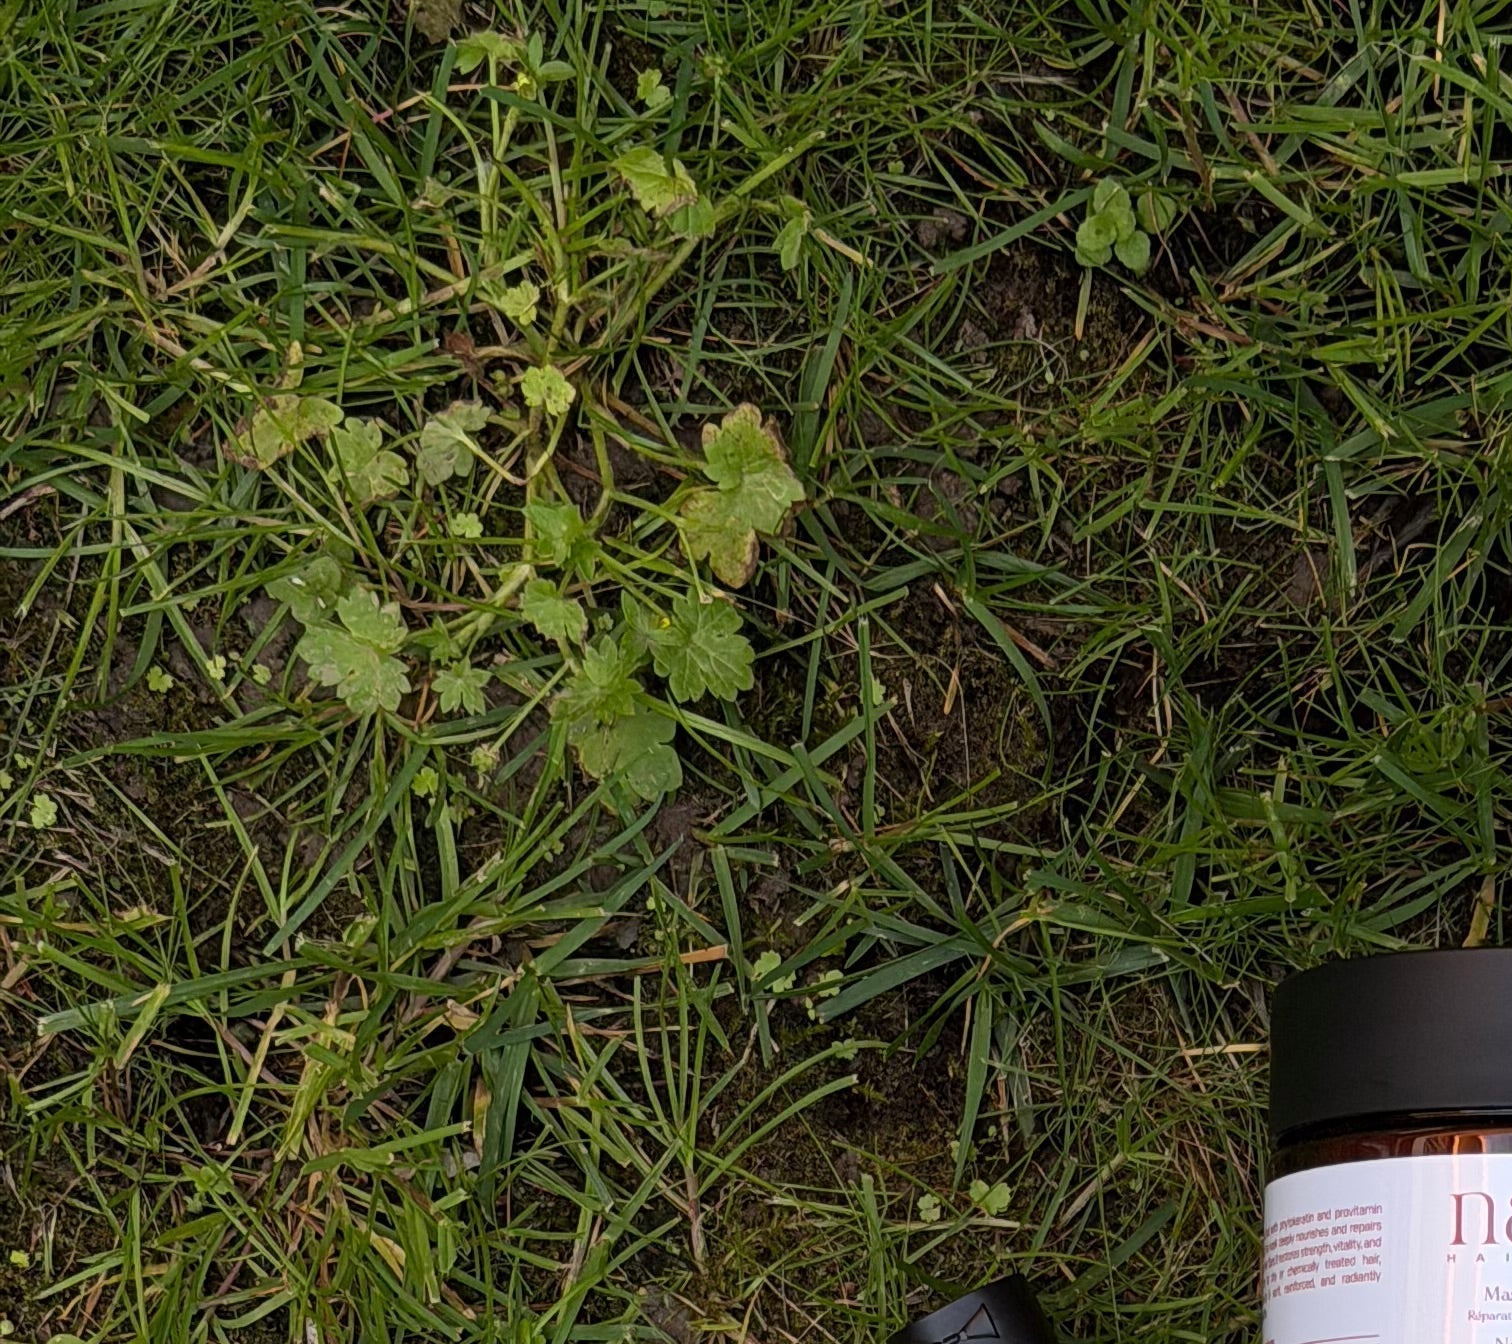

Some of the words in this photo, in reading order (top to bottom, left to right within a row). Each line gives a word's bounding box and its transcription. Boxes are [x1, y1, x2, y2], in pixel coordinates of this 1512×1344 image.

[1317, 1209, 1331, 1221] and
[1334, 1204, 1382, 1219] provitamin
[1331, 1224, 1347, 1235] and
[1350, 1221, 1382, 1234] repairs
[1364, 1237, 1382, 1248] and
[1325, 1256, 1356, 1269] treated
